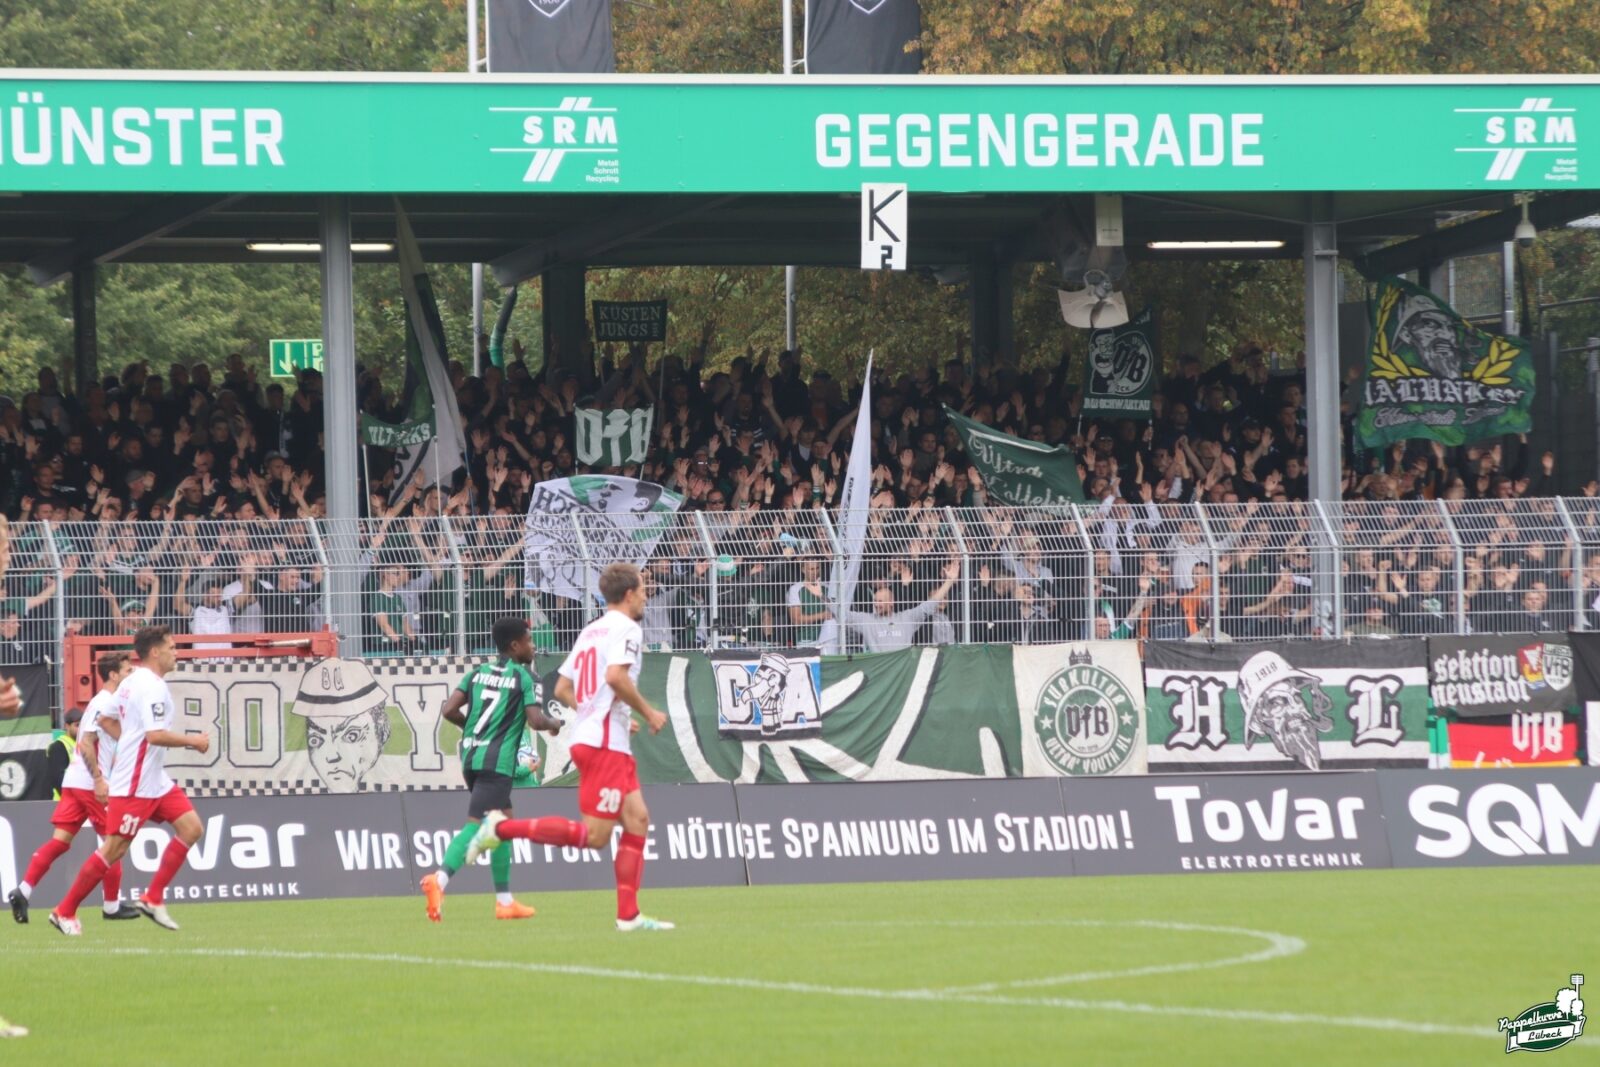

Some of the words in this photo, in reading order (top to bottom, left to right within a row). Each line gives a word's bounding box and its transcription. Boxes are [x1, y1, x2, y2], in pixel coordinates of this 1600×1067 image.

[0, 91, 286, 166] ÜNSTER
[522, 115, 618, 144] SRM
[814, 113, 1265, 168] GEGENGERADE
[1485, 116, 1577, 144] SRM
[868, 189, 904, 242] K
[881, 245, 893, 269] 2
[598, 322, 649, 337] JUNGS
[473, 688, 501, 735] 7
[596, 787, 622, 814] 20
[119, 813, 140, 839] 31
[334, 829, 405, 872] WIR
[667, 817, 776, 861] NÖTIGE
[781, 817, 940, 860] SPANNUNG
[947, 817, 989, 855] IM
[994, 809, 1136, 854] STADION!
[1181, 852, 1364, 871] ELEKTROTECHNIK
